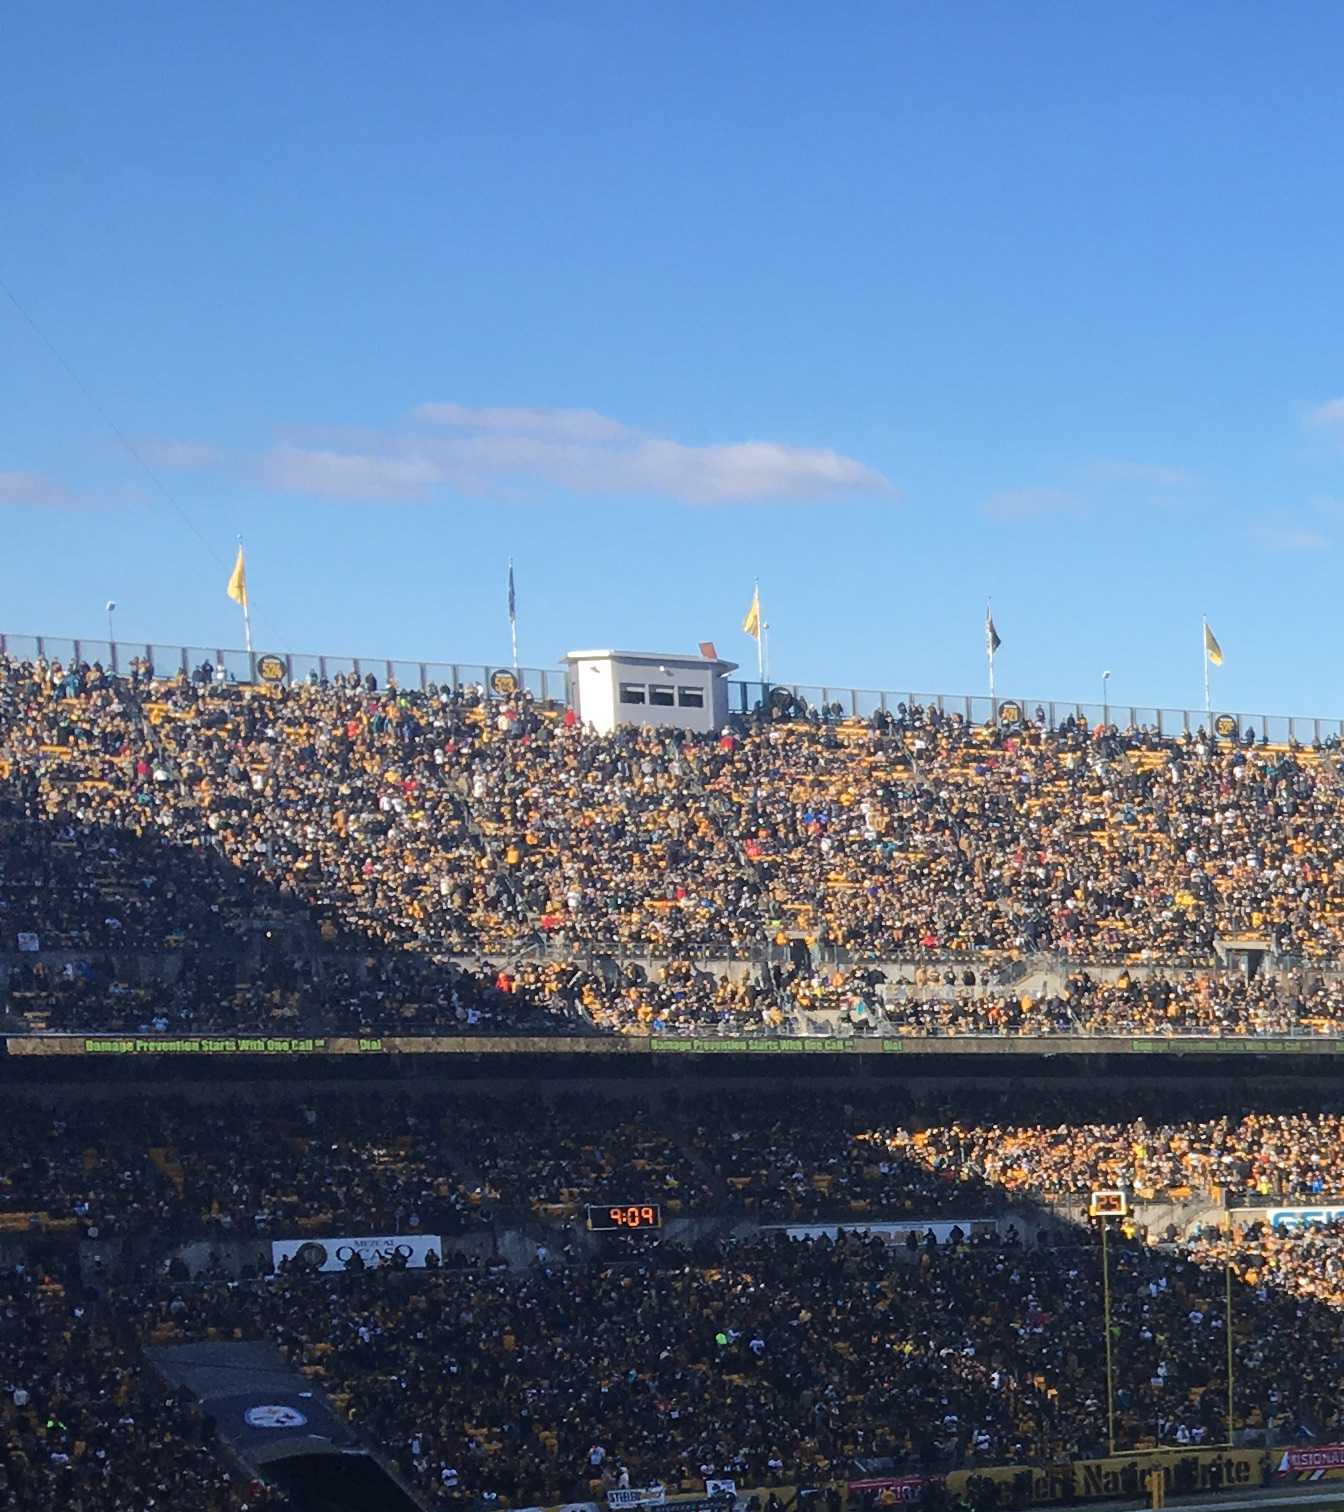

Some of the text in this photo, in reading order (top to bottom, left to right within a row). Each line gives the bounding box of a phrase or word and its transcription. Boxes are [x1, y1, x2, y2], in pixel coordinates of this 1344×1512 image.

[85, 1040, 134, 1053] Damage
[136, 1040, 199, 1052] Prevention
[201, 1040, 236, 1052] Starts
[238, 1040, 265, 1052] With
[267, 1040, 289, 1052] One
[291, 1040, 313, 1052] Call
[359, 1040, 382, 1051] Dial
[610, 1207, 654, 1227] 9:09
[354, 1239, 395, 1248] MEZCAL
[335, 1244, 414, 1265] OCASO
